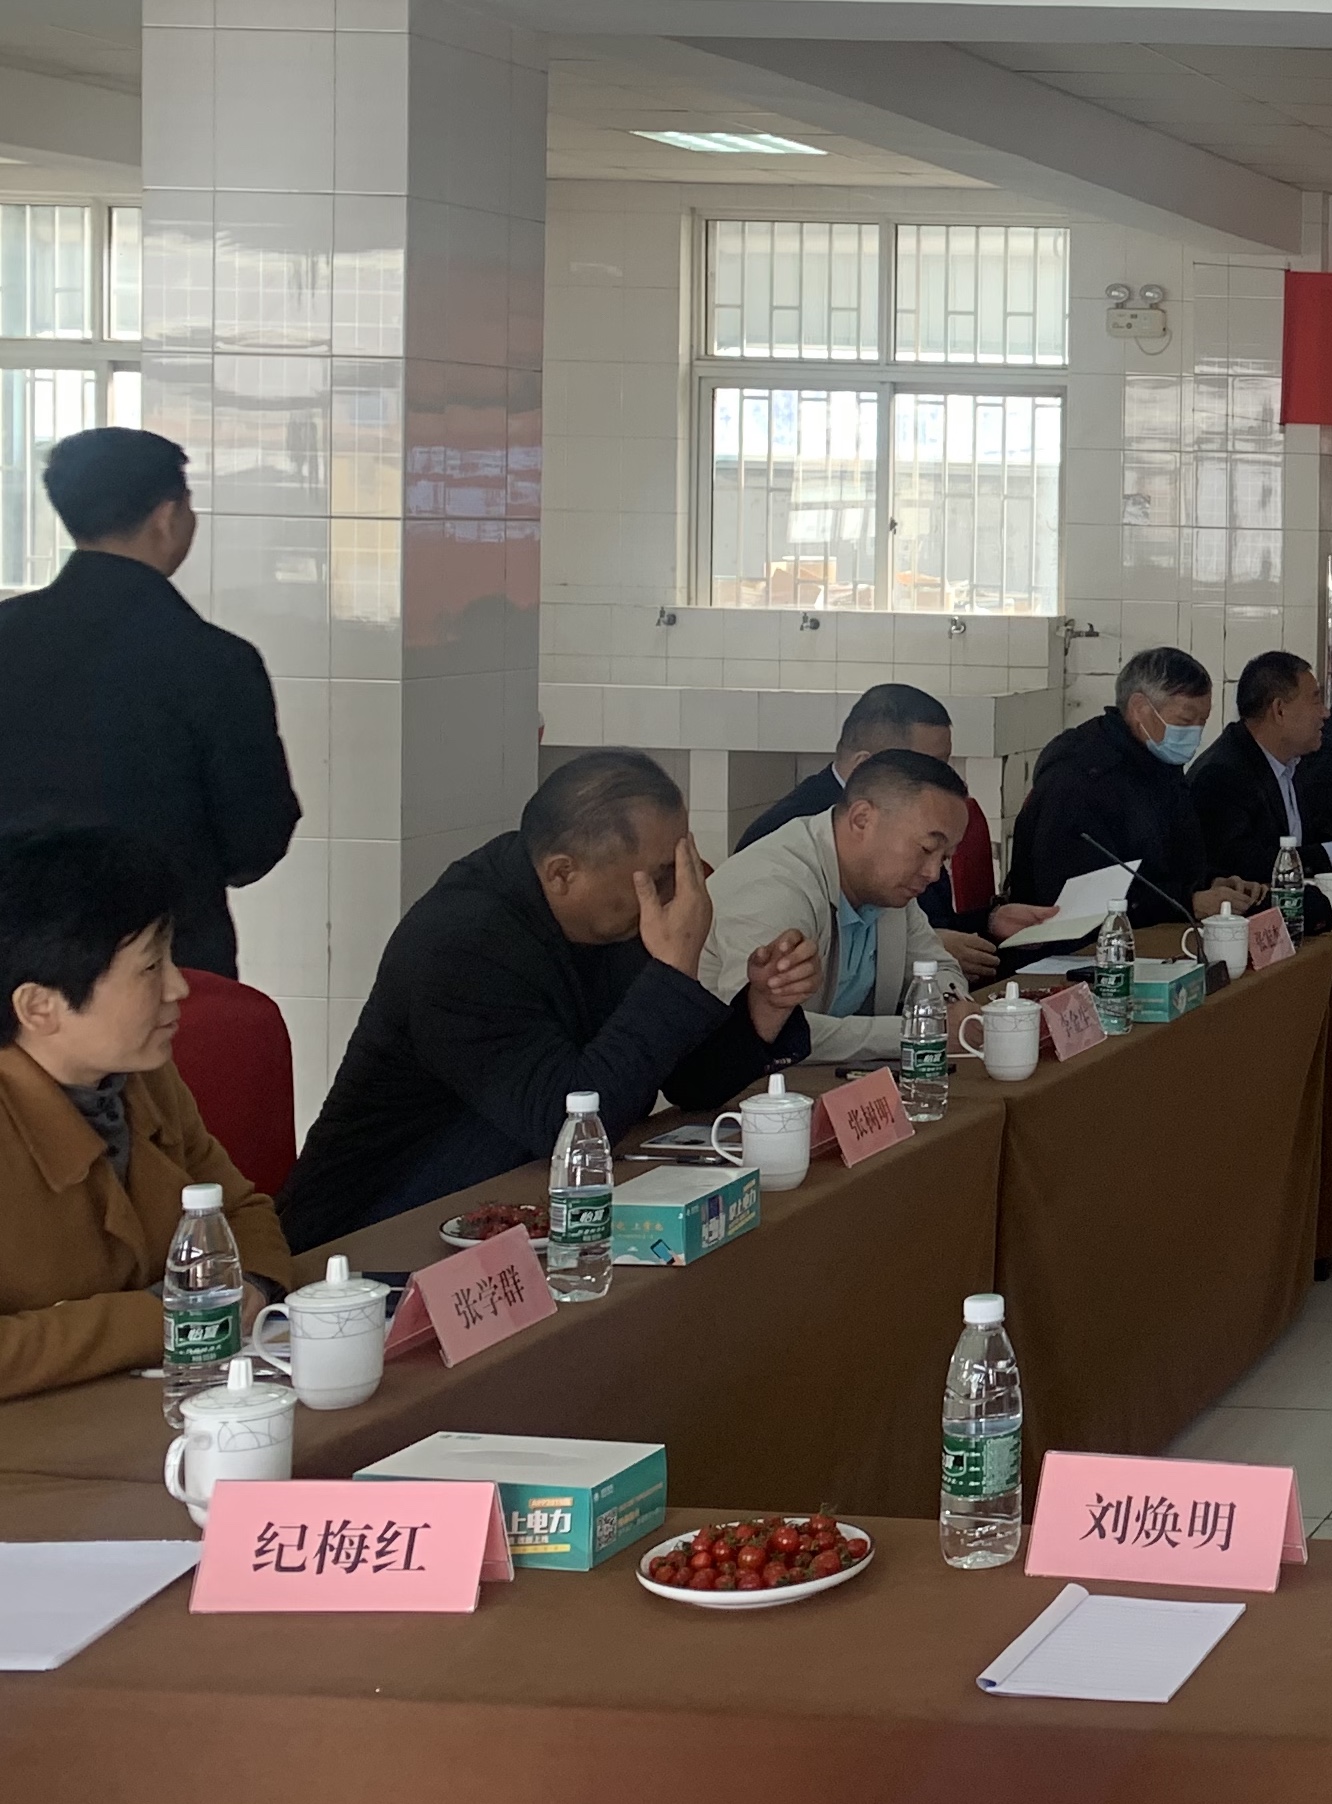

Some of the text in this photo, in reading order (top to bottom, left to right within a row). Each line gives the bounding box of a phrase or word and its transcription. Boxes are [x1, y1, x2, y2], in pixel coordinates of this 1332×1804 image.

[847, 1096, 895, 1141] 张树明
[453, 1263, 527, 1330] 张学群
[252, 1517, 432, 1576] 纪梅红
[1080, 1492, 1238, 1554] 刘焕明
